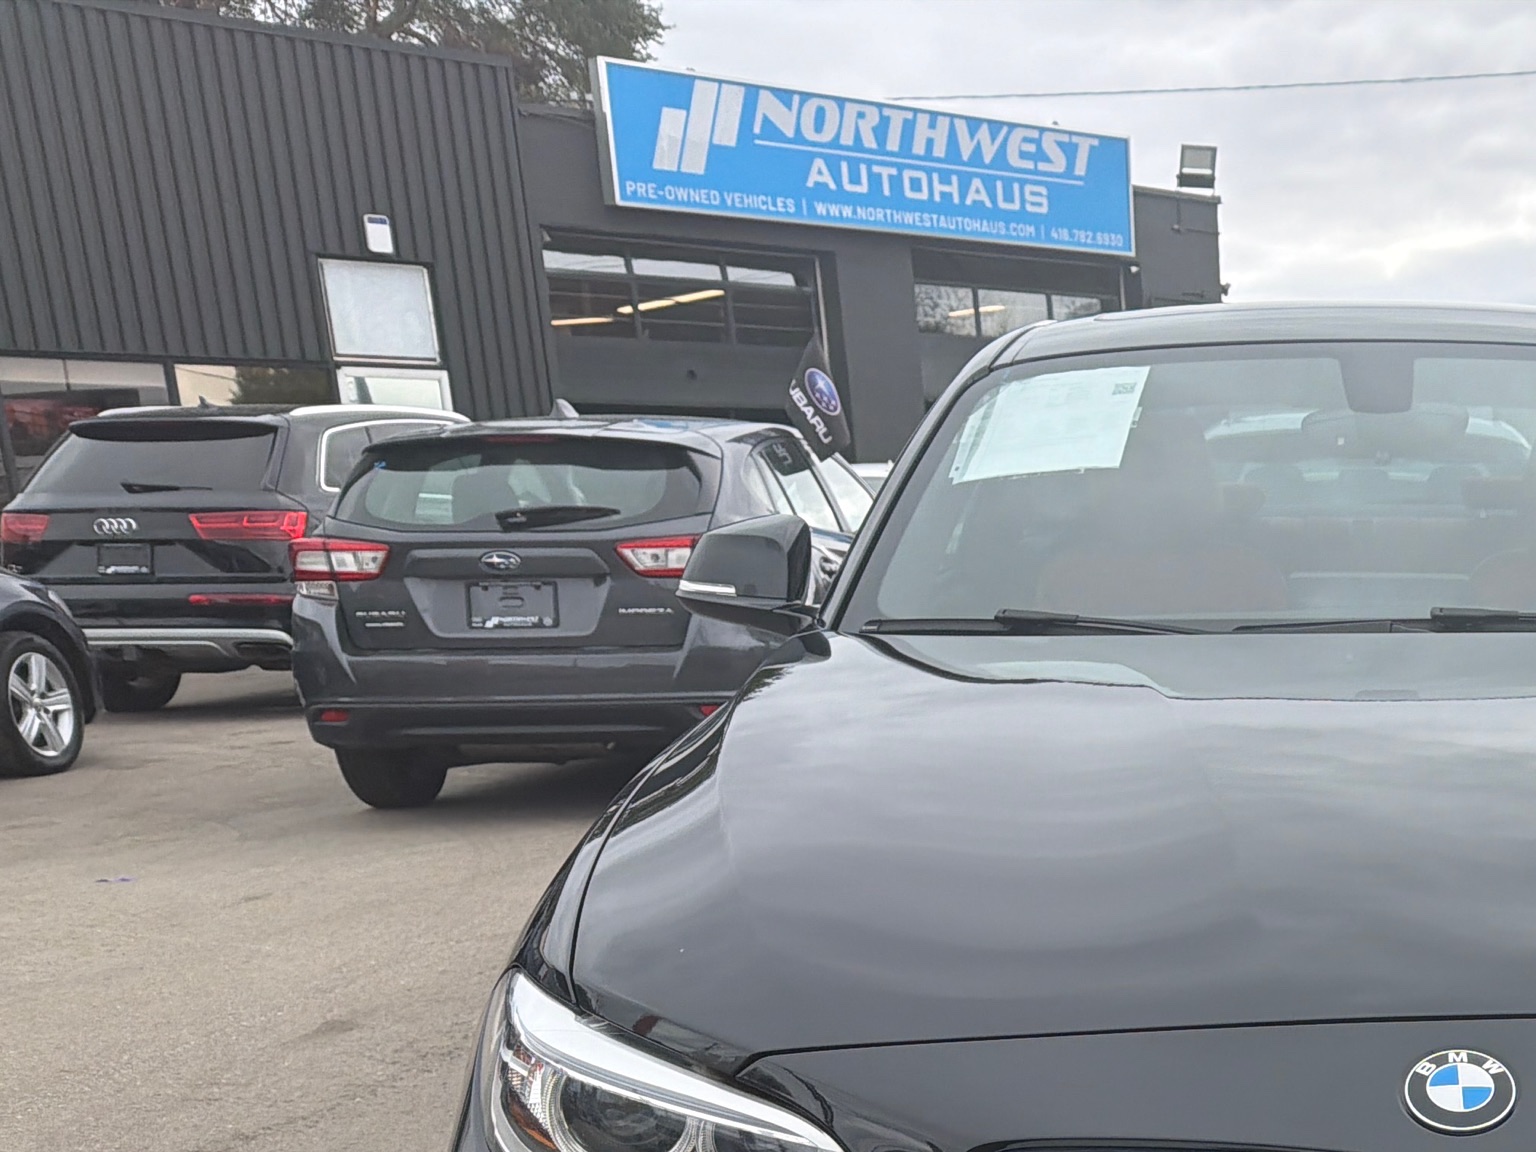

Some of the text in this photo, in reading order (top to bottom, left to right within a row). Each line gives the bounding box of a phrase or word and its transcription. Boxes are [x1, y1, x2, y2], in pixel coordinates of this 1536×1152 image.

[754, 89, 1099, 177] NORTHWEST
[625, 180, 720, 206] PRE-OWNED
[723, 192, 796, 214] VEHICLES
[814, 201, 1035, 238] WWW.NORTHWESTAUTOHAUS.COM
[806, 157, 1049, 214] AUTOHAUS
[788, 378, 833, 445] UBARU
[1415, 1051, 1505, 1077] BMW
